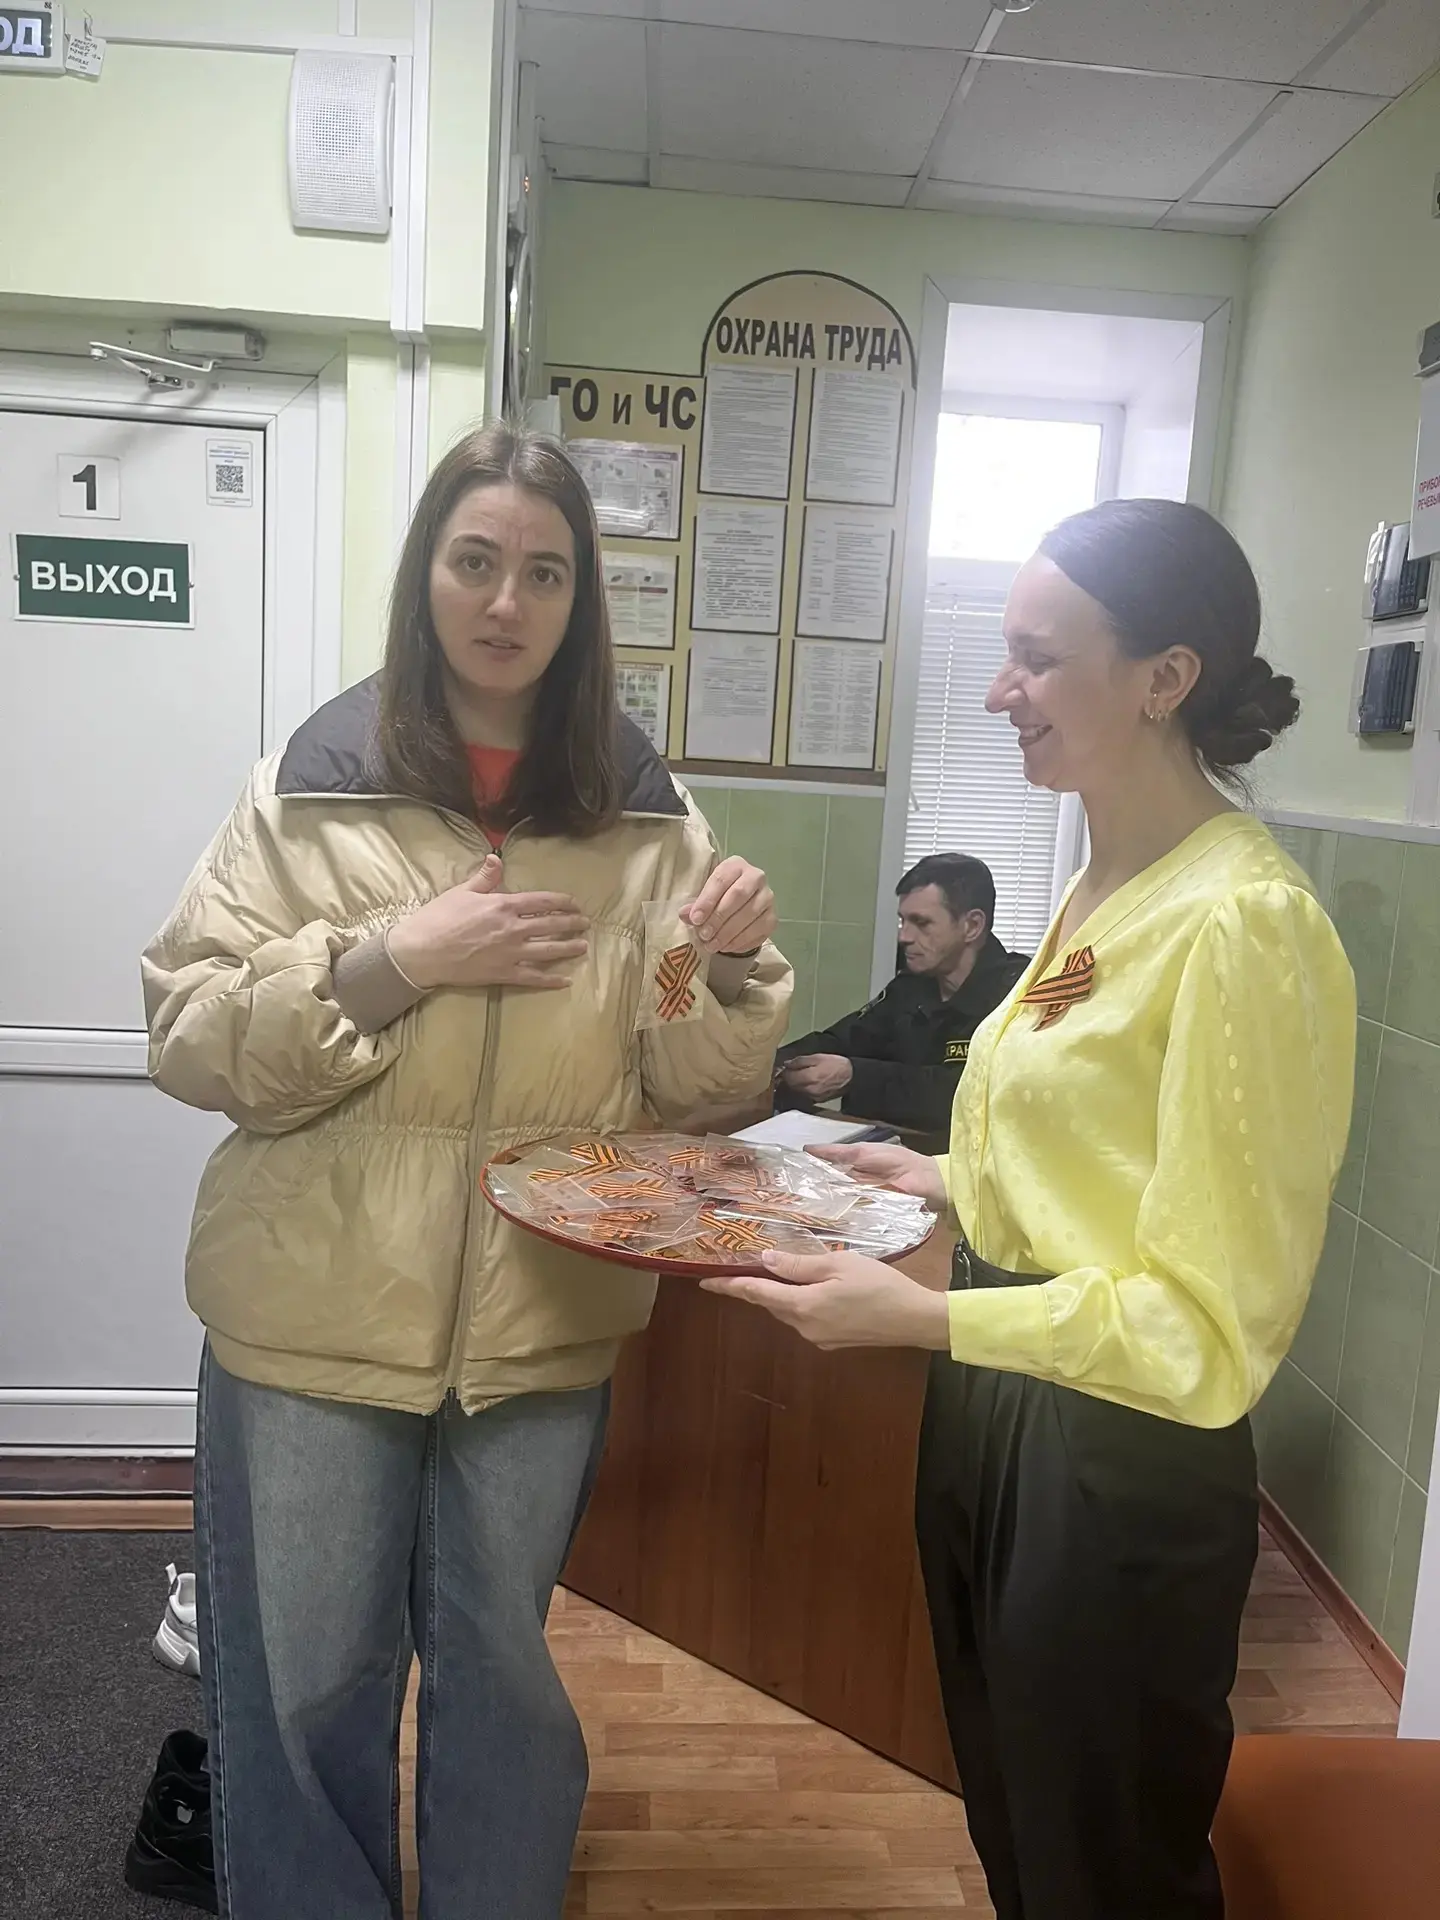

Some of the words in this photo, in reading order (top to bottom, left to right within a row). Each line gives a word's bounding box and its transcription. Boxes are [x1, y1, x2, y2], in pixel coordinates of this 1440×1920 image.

[716, 317, 816, 360] ОХРАНА
[824, 324, 902, 371] ТРУДА
[550, 376, 599, 422] ГО
[645, 384, 697, 431] ЧС
[72, 464, 97, 511] 1
[30, 560, 177, 603] ВЫХОД
